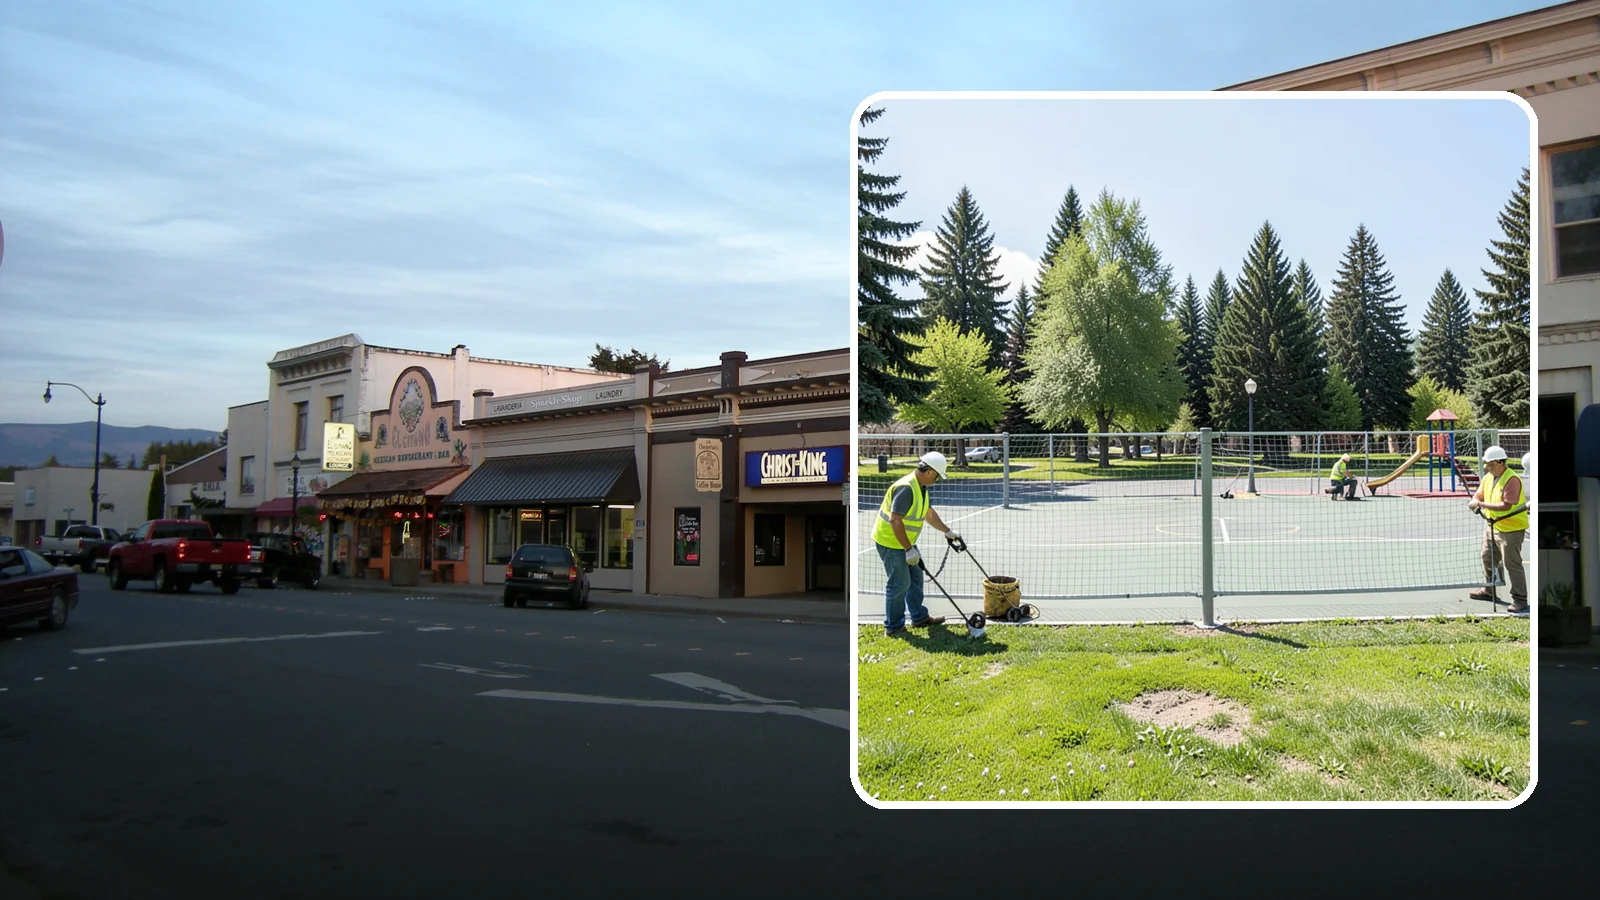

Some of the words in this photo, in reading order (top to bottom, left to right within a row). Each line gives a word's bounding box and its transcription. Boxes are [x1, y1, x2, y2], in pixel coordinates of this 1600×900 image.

[531, 396, 560, 408] Sparkle
[561, 394, 582, 405] Shop
[595, 389, 623, 399] LAUNDRY
[493, 402, 522, 412] LAVANDERIA
[373, 455, 396, 464] MEXICAN
[397, 451, 433, 462] RESTAURANT
[437, 450, 450, 458] BAR
[761, 452, 797, 478] CHRIST
[799, 450, 827, 476] KING
